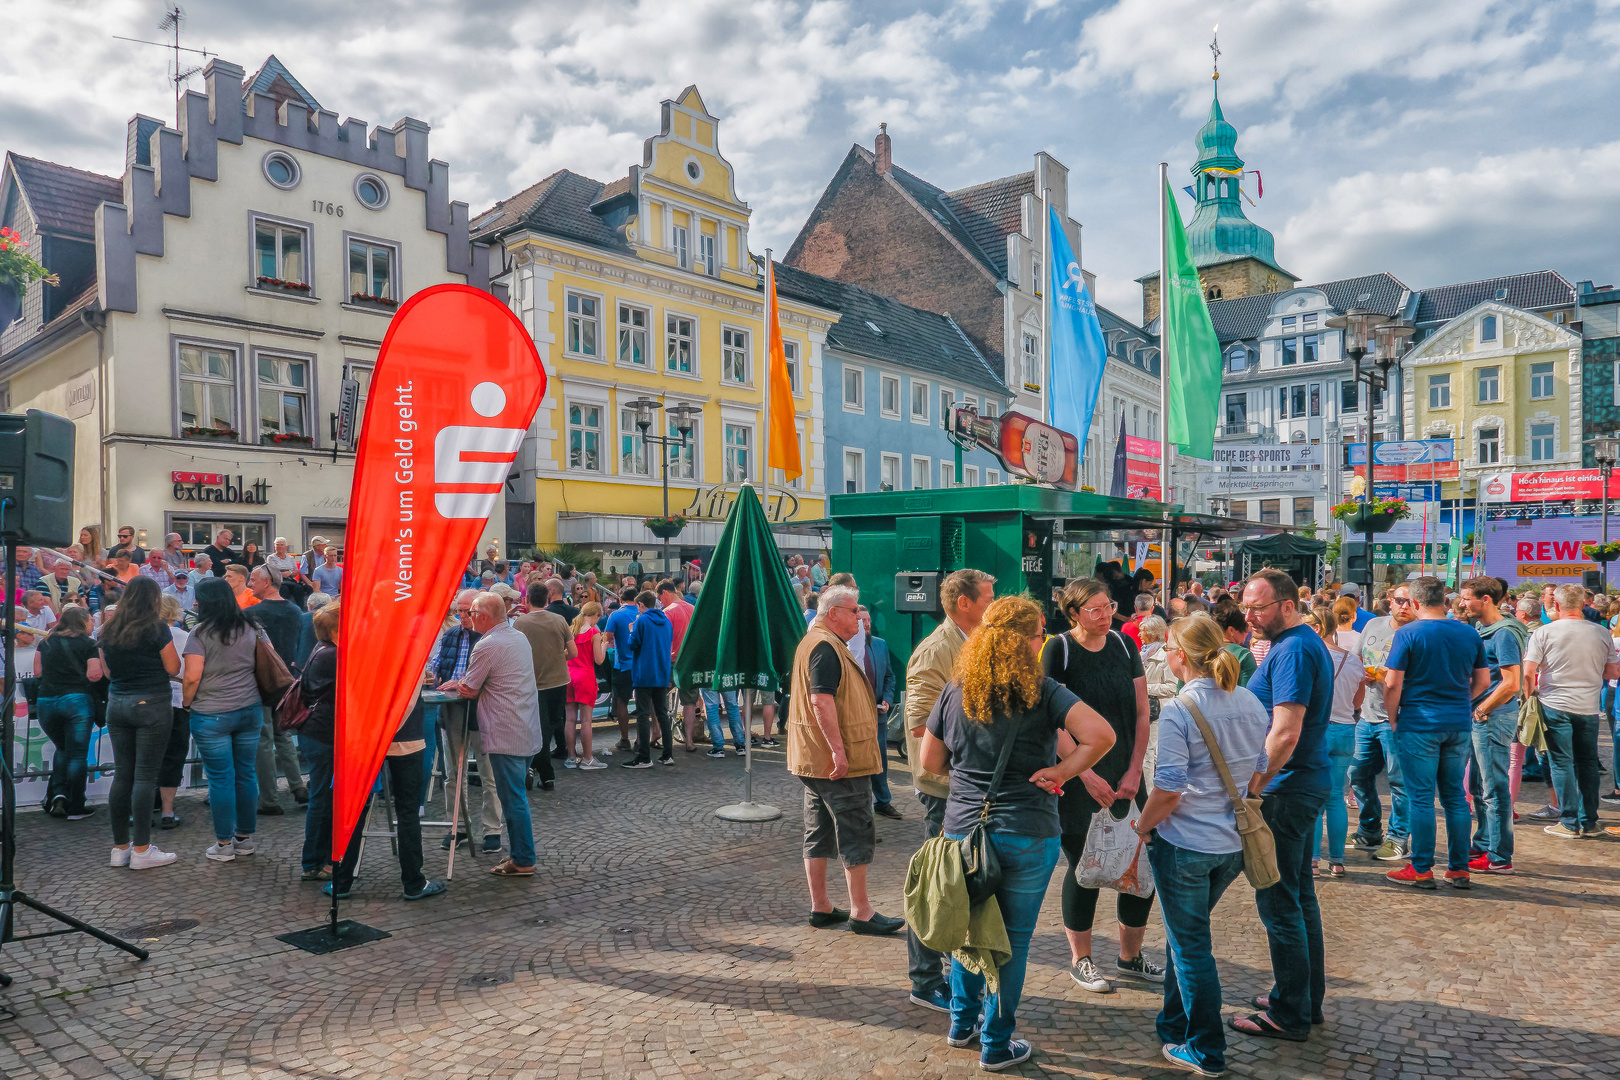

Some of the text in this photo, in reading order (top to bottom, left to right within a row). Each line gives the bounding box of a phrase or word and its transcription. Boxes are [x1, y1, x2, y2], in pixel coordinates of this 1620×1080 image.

[312, 199, 344, 218] 1766
[340, 386, 353, 442] extrablatt
[1036, 428, 1050, 481] FIEGE
[1239, 449, 1256, 462] DES
[1258, 449, 1291, 462] SPORTS
[175, 472, 222, 483] CAFÉ
[1518, 477, 1538, 485] Hoch
[1565, 475, 1576, 483] ist
[173, 474, 273, 505] extrablatt
[394, 380, 417, 602] Wenn's um Geld geht.
[1218, 480, 1294, 489] Marktplatzspringen
[312, 496, 349, 509] Alber
[682, 481, 800, 522] Nüel
[1430, 552, 1447, 560] FEGE
[1021, 556, 1043, 572] FIEGE
[1522, 565, 1593, 576] Kramer
[907, 593, 925, 602] peki
